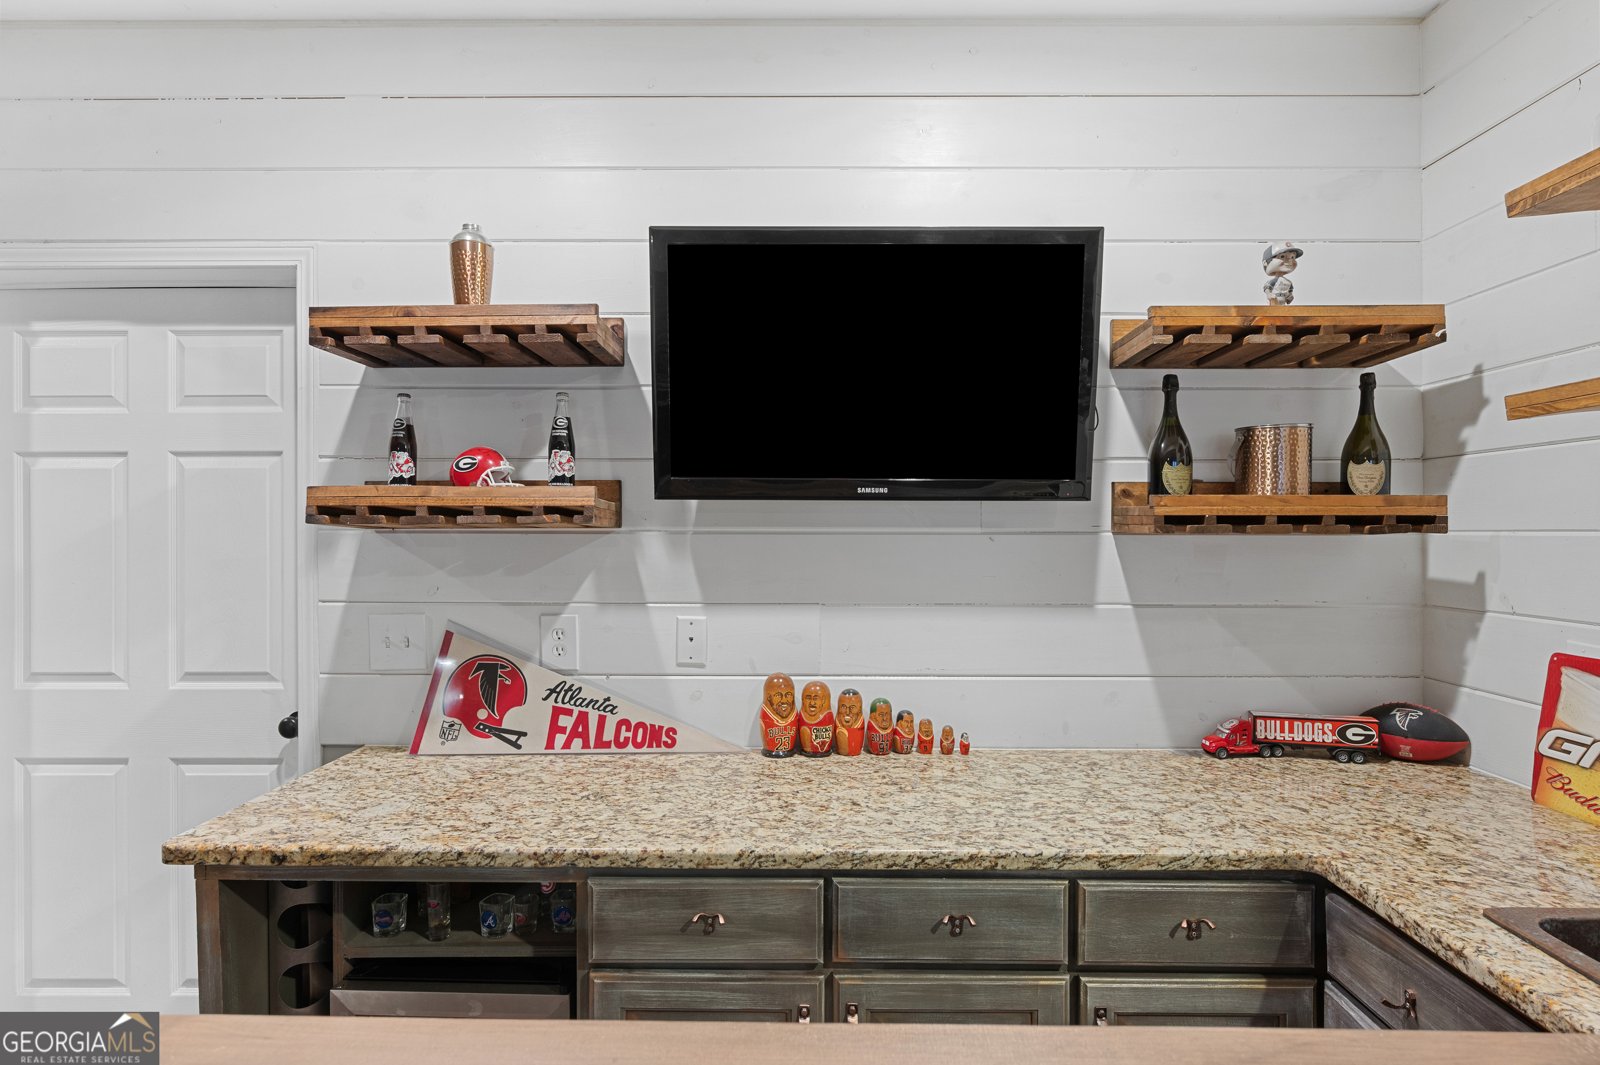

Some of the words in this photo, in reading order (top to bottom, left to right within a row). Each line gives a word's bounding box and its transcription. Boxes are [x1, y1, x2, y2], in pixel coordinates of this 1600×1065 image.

[457, 457, 478, 469] G
[541, 680, 619, 715] Atlanta
[440, 728, 458, 740] NFL
[544, 705, 678, 750] FALCONS
[1256, 719, 1333, 743] BULLDOGS
[1343, 726, 1377, 742] G
[775, 736, 790, 751] 23
